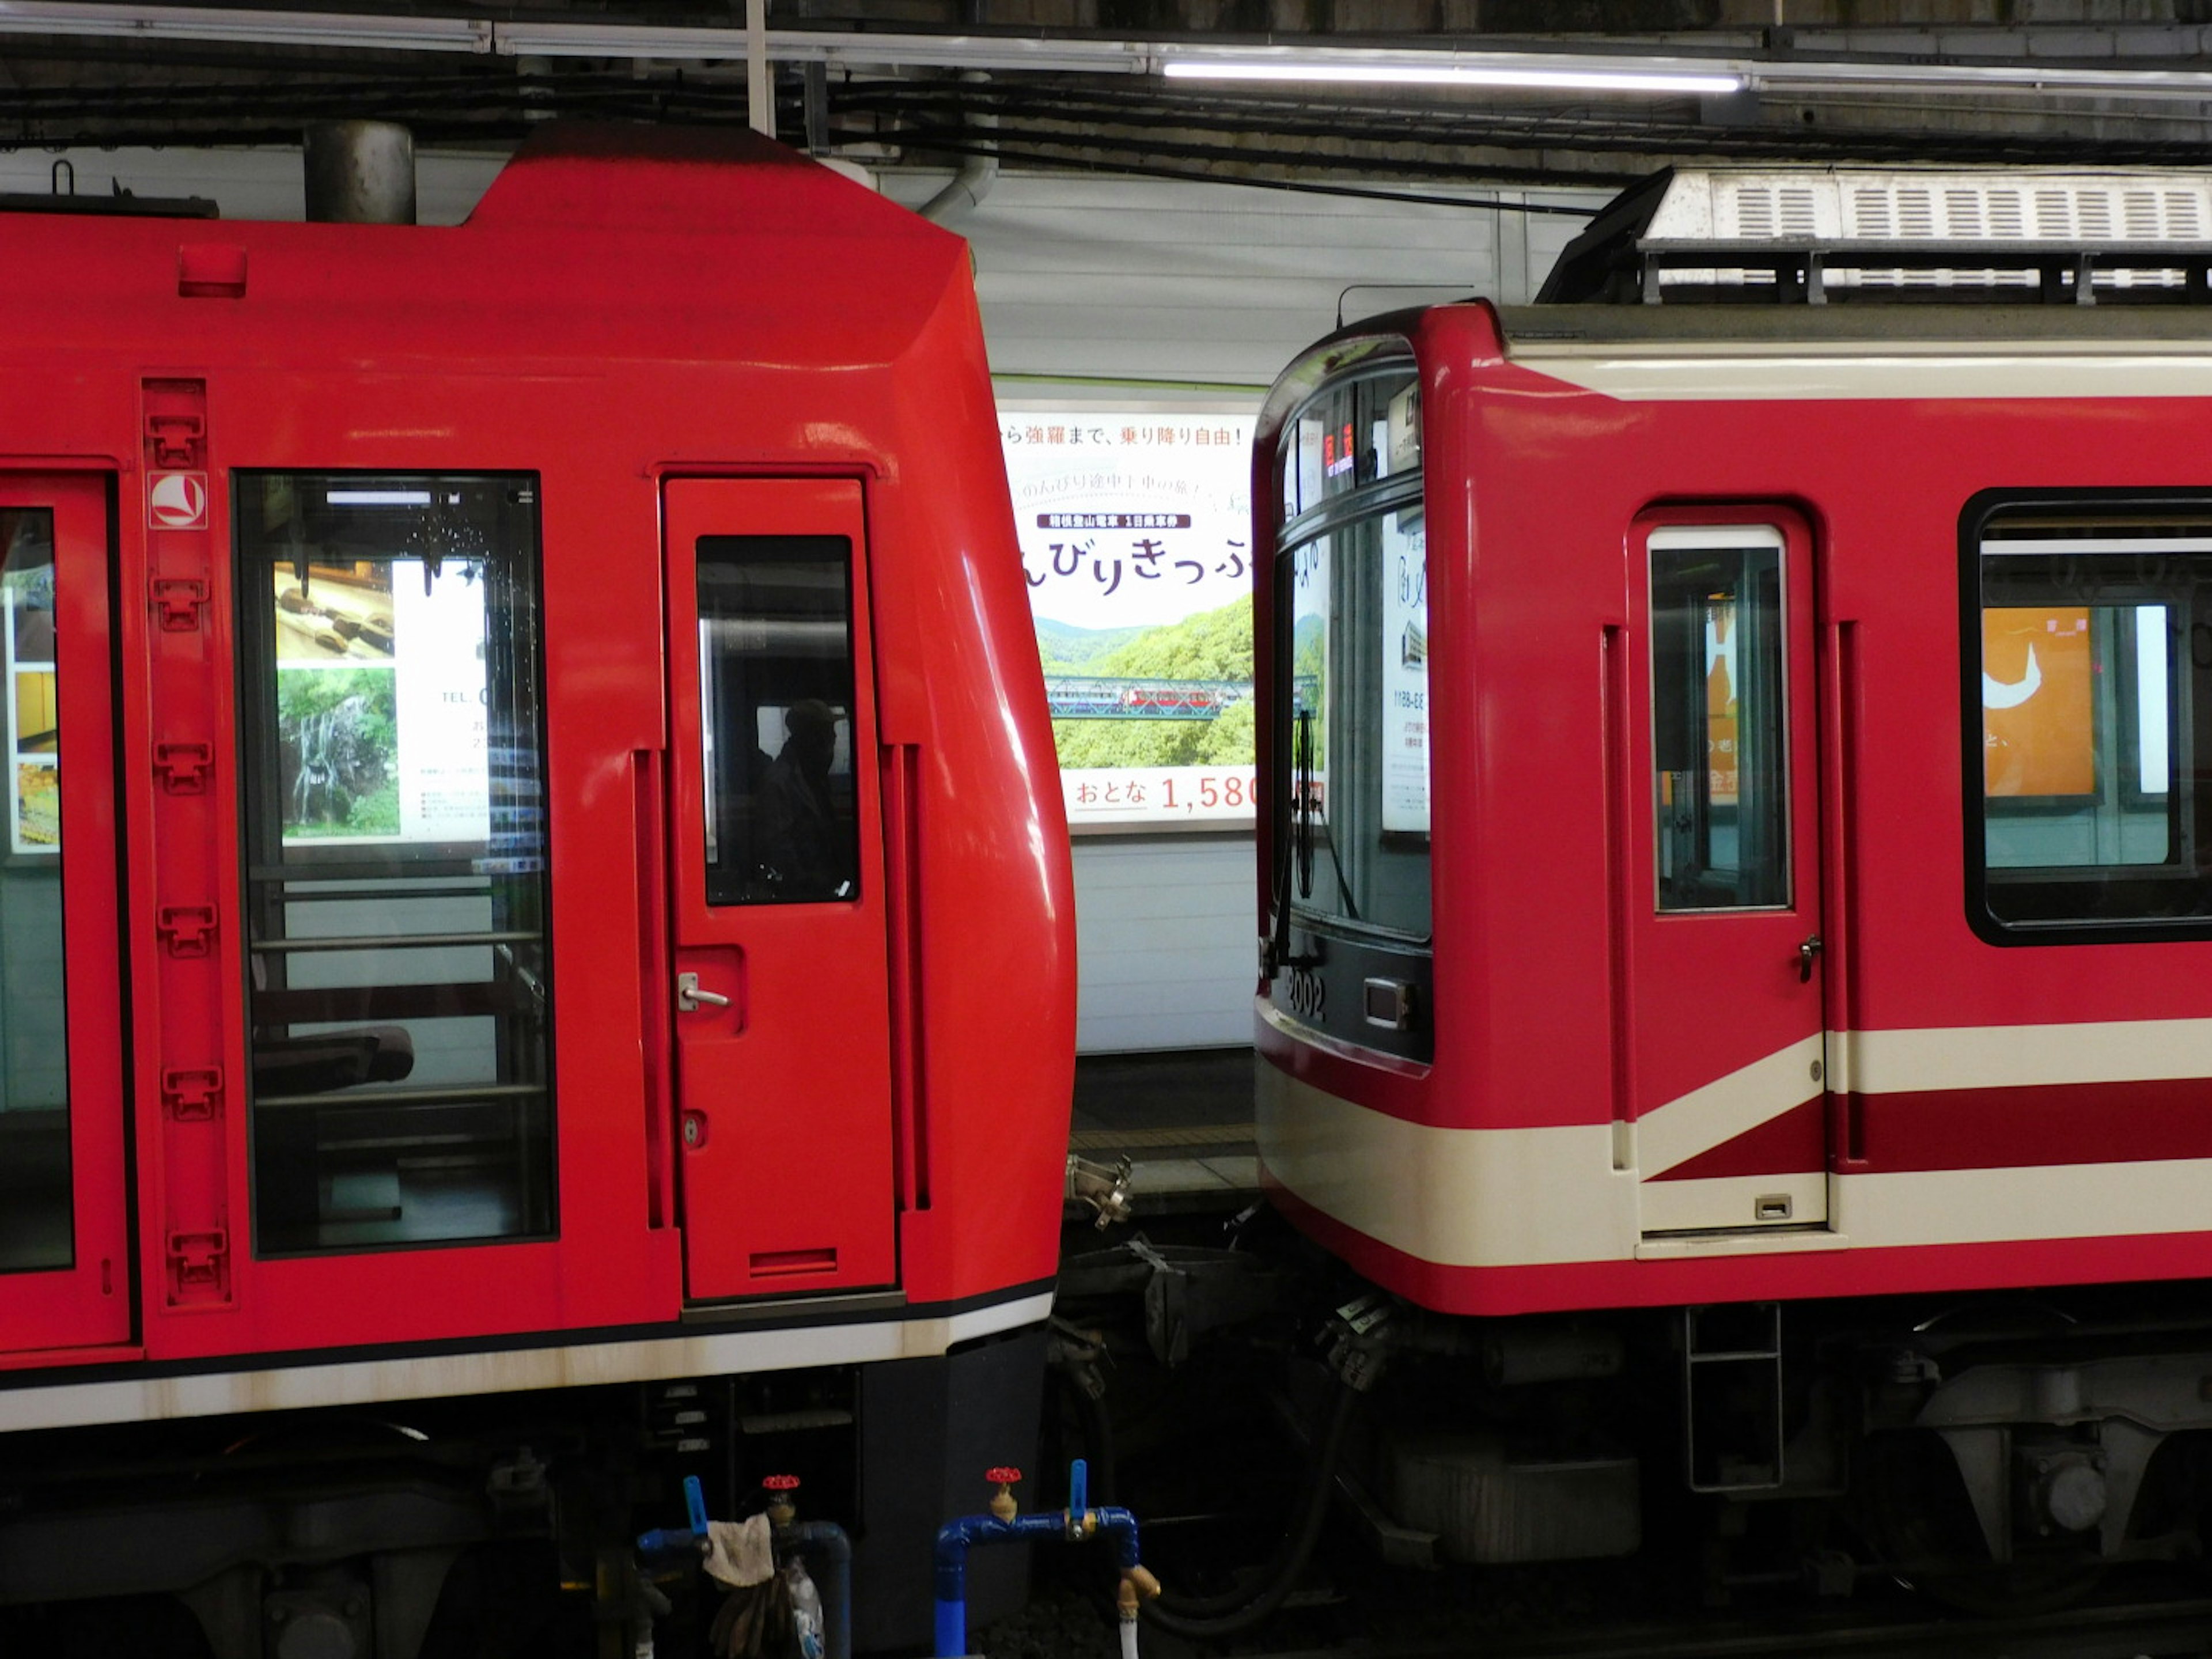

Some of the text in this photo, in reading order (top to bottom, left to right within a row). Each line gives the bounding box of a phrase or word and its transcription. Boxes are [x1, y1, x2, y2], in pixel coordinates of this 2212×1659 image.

[1000, 426, 1241, 446] ら強羅まで、乗り降り自由!
[1076, 781, 1146, 804] おとな
